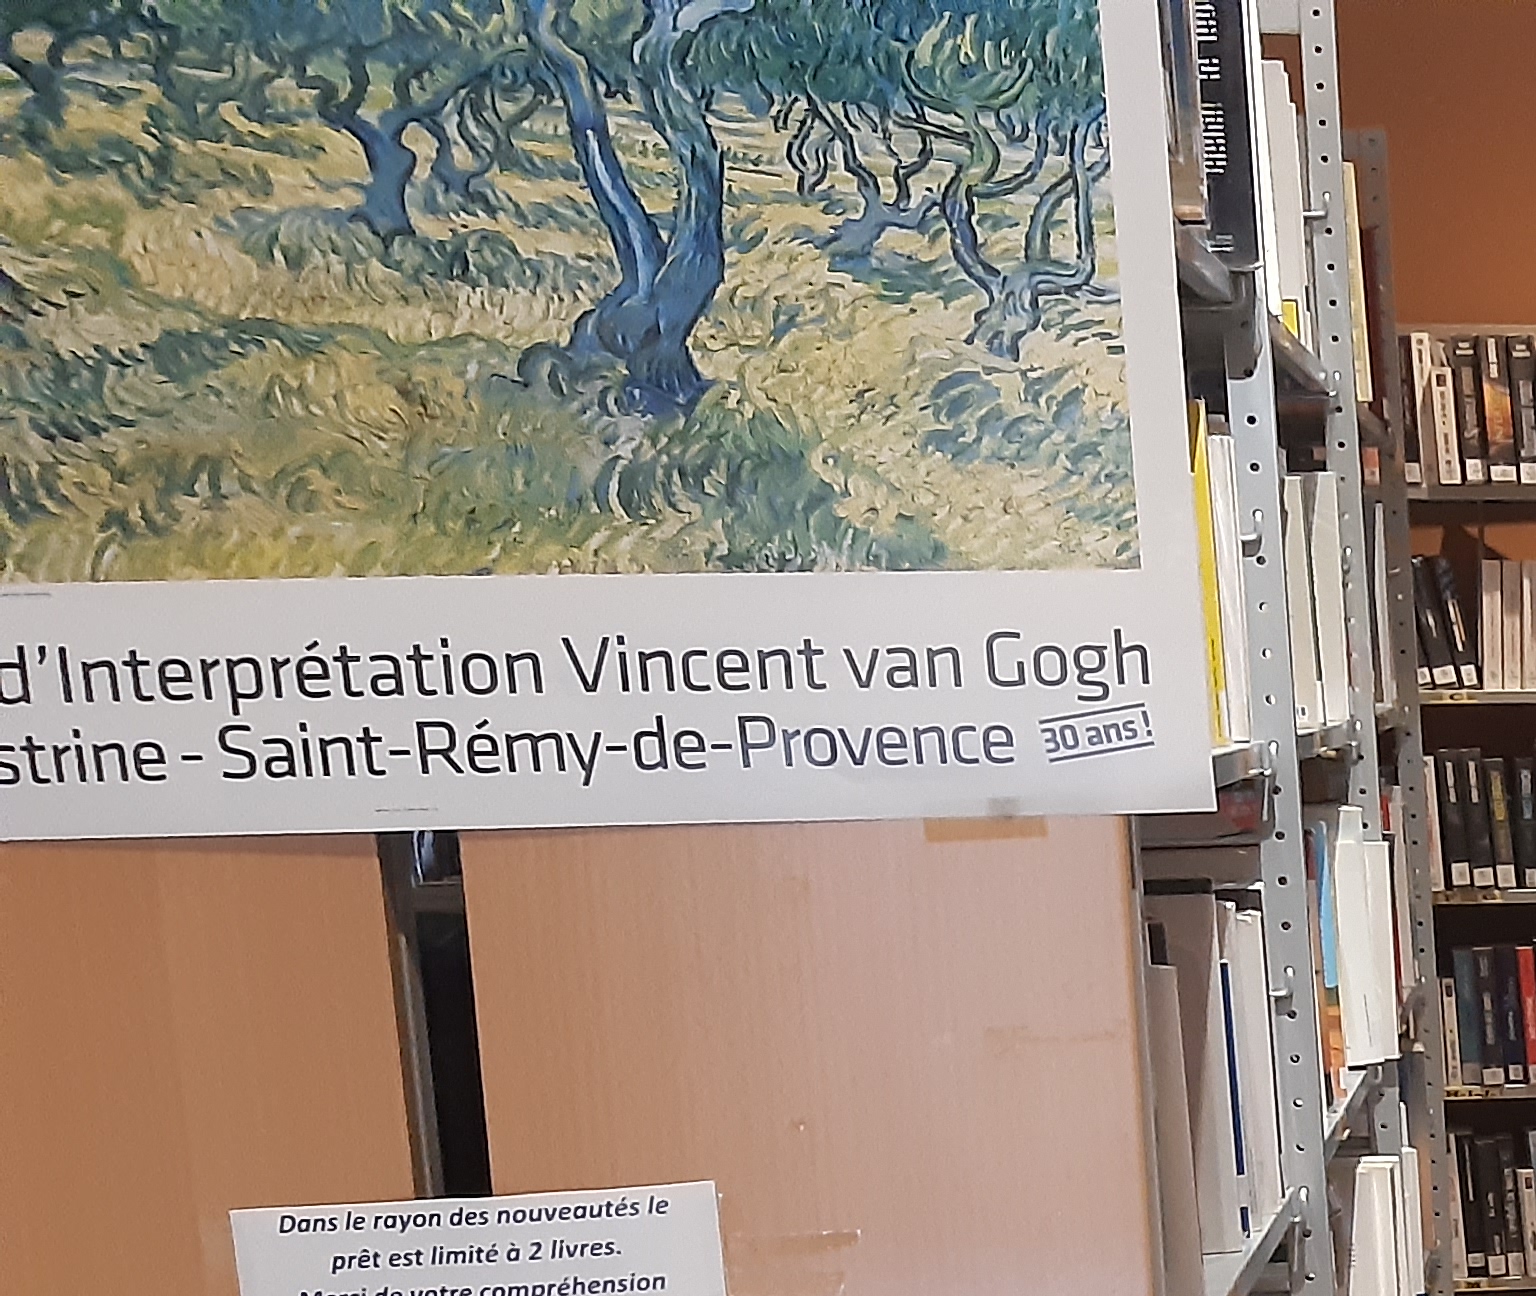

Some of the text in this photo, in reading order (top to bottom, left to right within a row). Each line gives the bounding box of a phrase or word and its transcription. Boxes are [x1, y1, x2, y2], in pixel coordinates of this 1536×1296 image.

[0, 628, 1153, 718] d'Interprétation Vincent van Gogh
[220, 711, 1017, 790] Saint-Rémy-de-Provence
[1041, 710, 1155, 757] 30 ans!
[278, 1195, 670, 1236] Dans le rayon des nouveautés le
[331, 1237, 623, 1275] prêt est limité à 2 livres.
